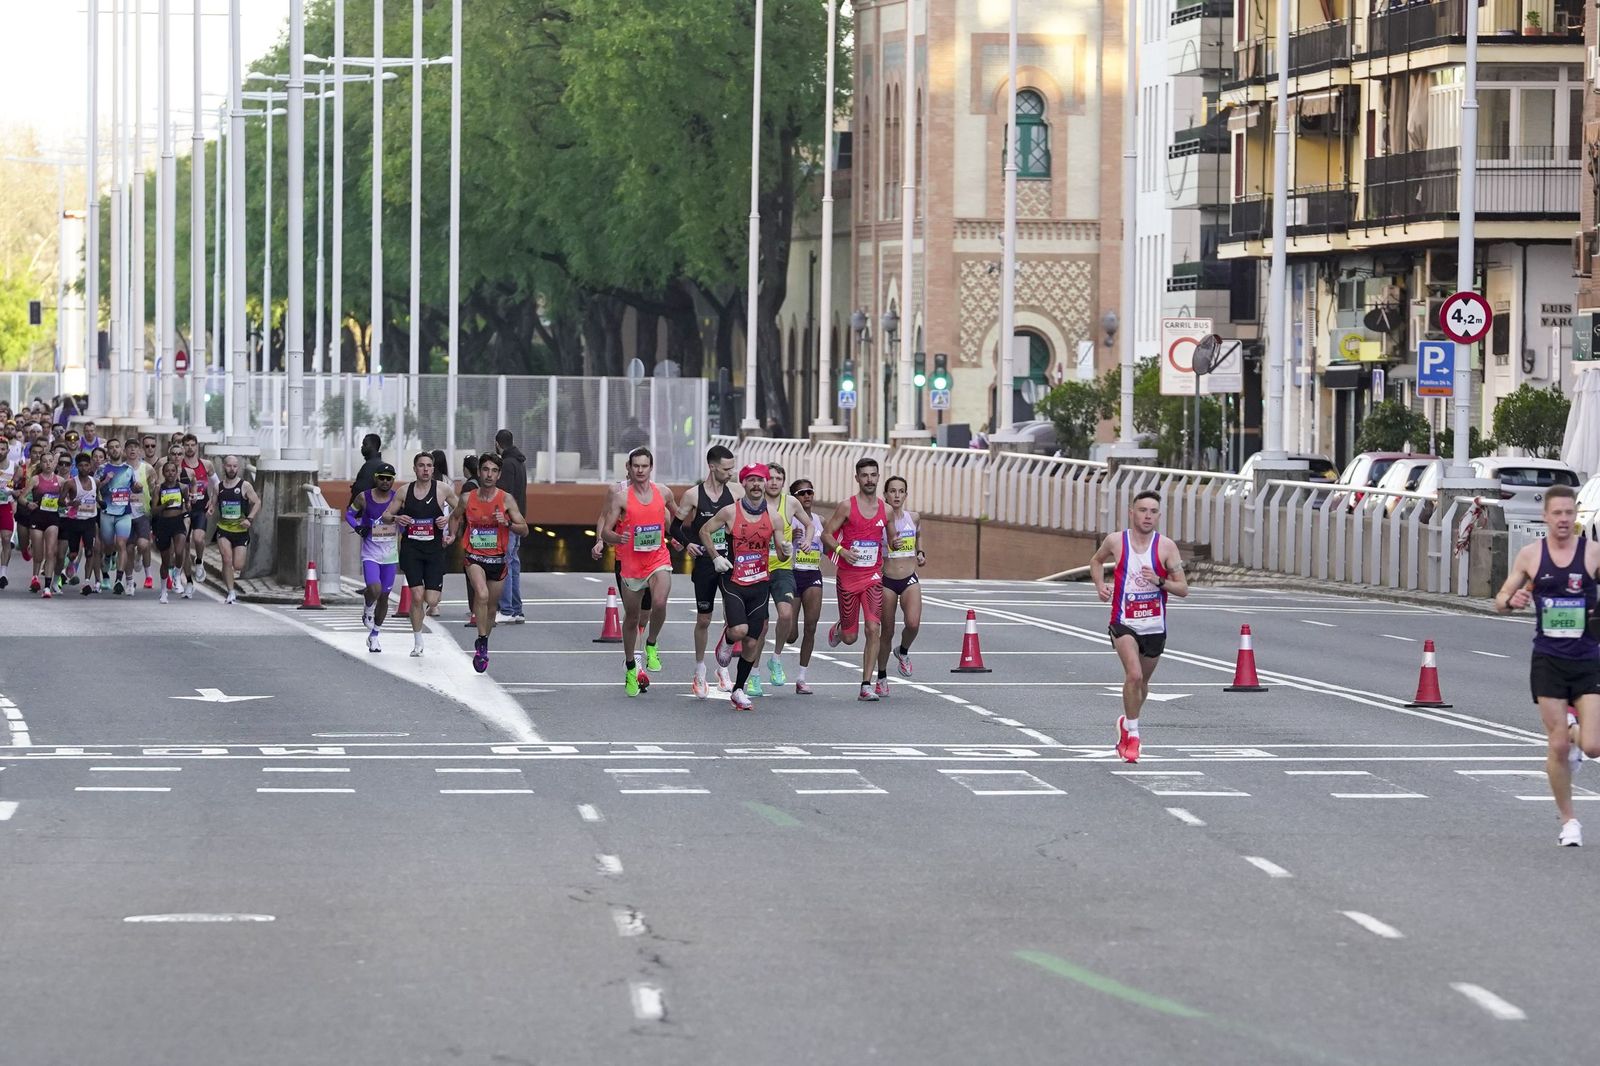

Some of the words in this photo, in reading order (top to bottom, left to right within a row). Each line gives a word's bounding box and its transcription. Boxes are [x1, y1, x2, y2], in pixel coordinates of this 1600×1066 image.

[1541, 303, 1572, 313] LUIS
[1423, 346, 1446, 375] P
[1133, 609, 1154, 618] EDDIE
[1551, 619, 1576, 628] SPEED
